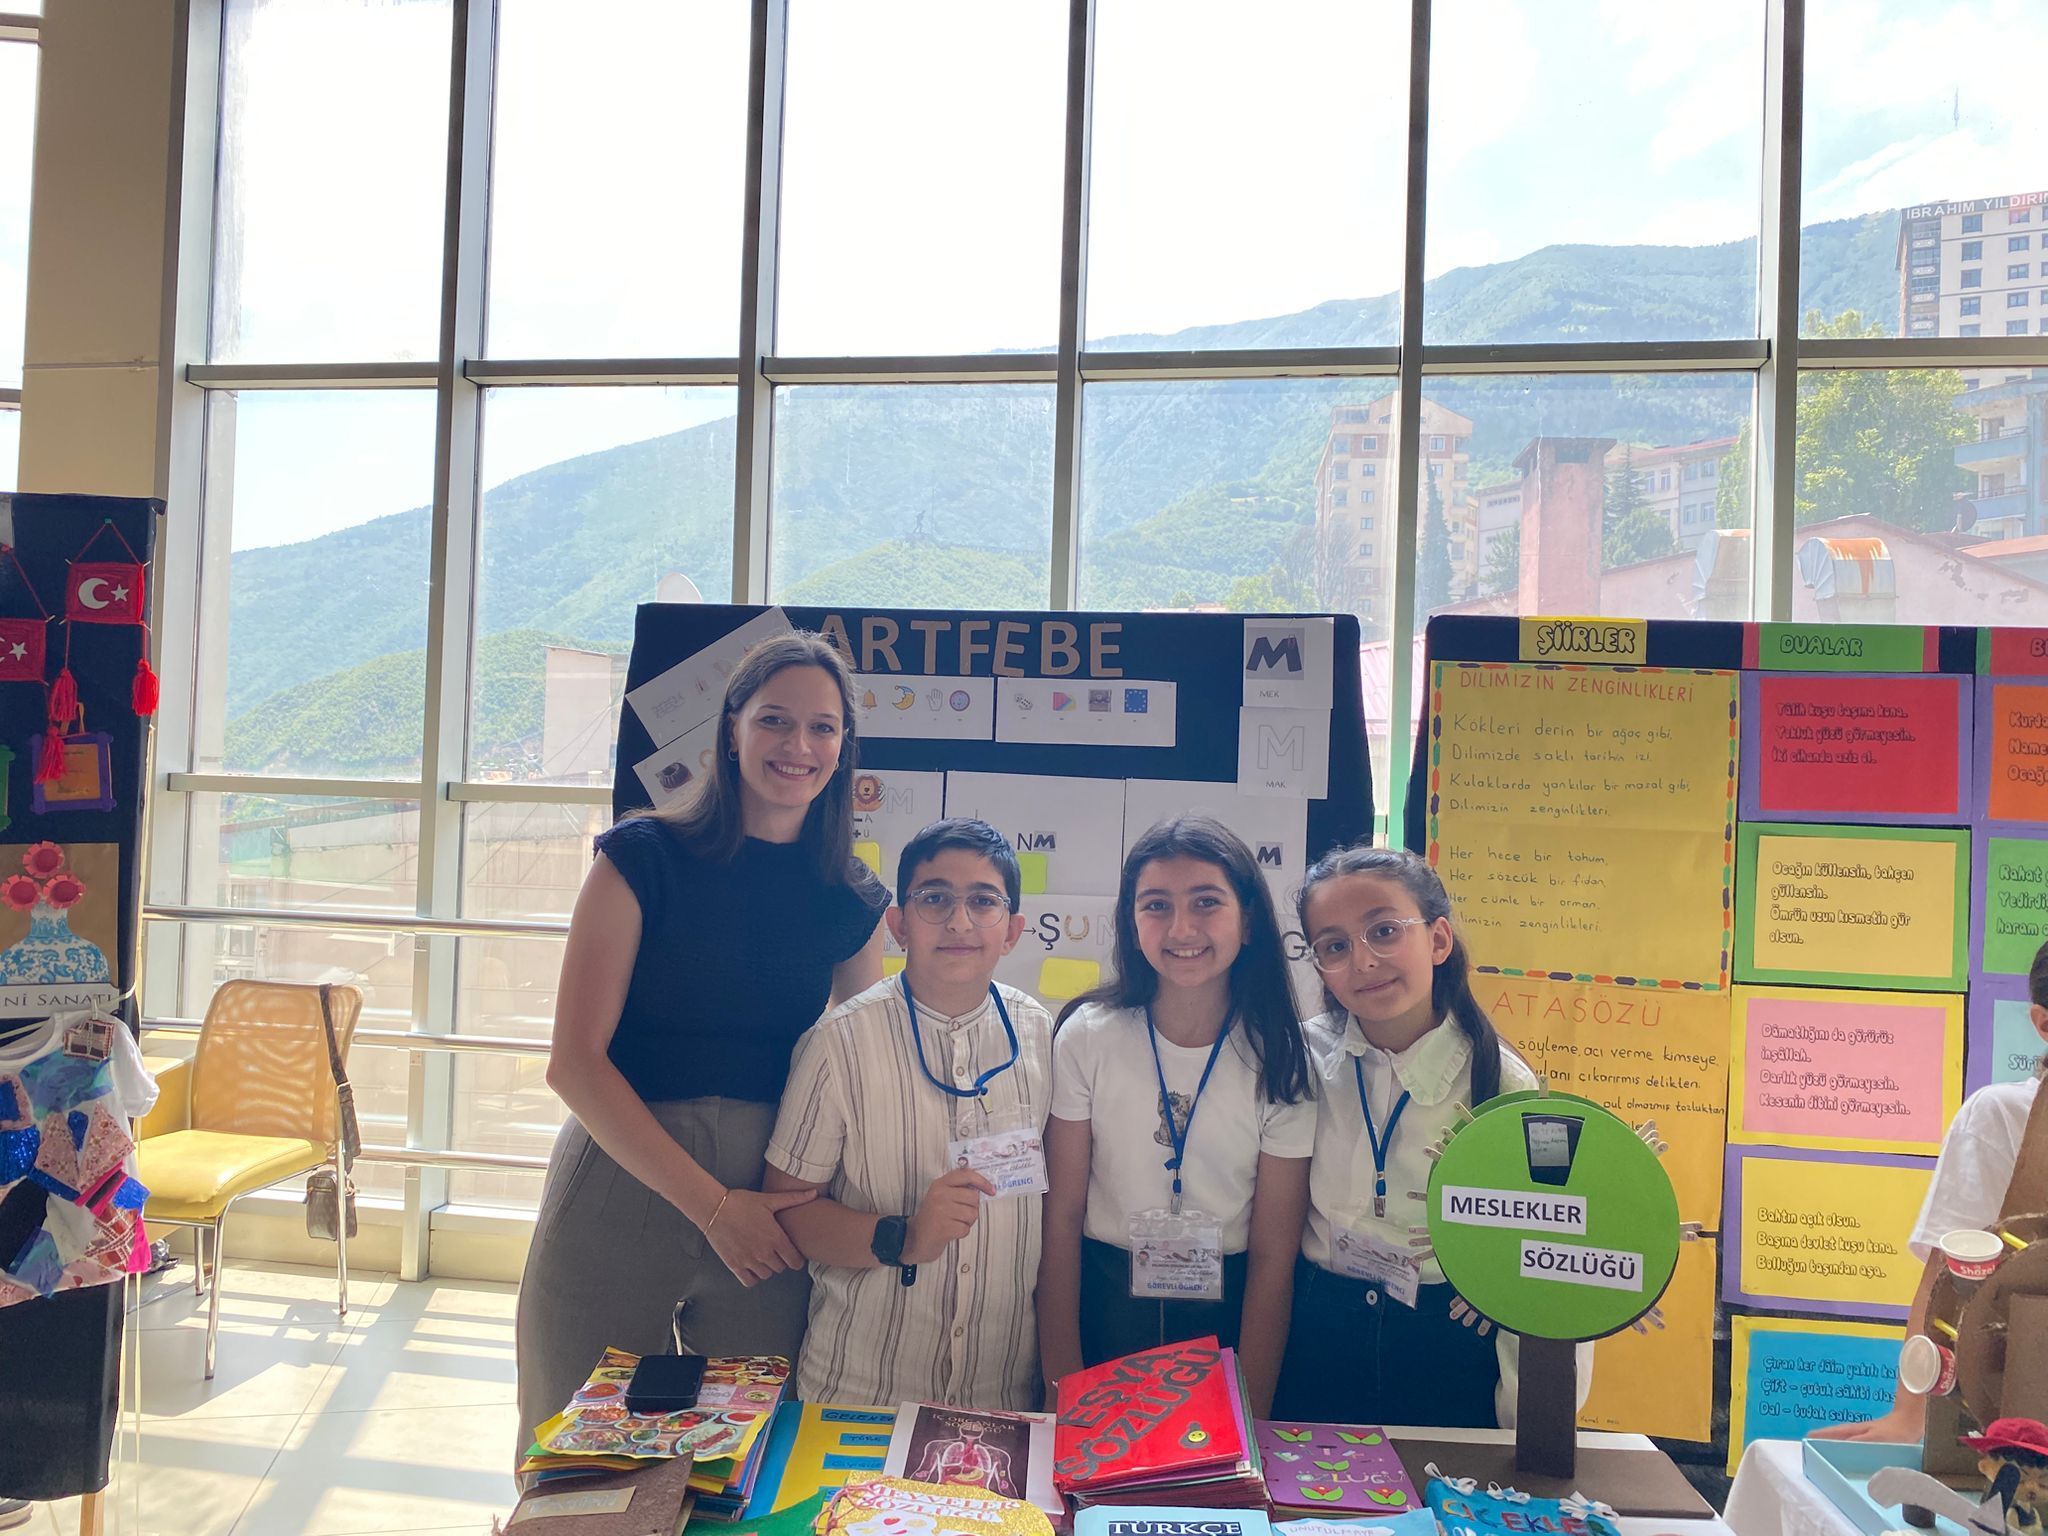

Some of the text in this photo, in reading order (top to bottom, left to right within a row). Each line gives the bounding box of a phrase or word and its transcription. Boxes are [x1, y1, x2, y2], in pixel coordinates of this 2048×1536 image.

[819, 614, 1124, 678] ARTFEBE
[1537, 621, 1635, 655] ŞİİRLER
[1780, 634, 1863, 657] DUALAR
[1535, 718, 1574, 737] derin
[1452, 743, 1521, 761] Dilimizde
[1450, 773, 1531, 790] Kulaklarda
[1450, 846, 1473, 859] Her
[1488, 846, 1521, 862] hece
[1450, 869, 1473, 881] Her
[1488, 872, 1537, 884] sözcük
[1772, 861, 1812, 879] Ocağın
[1874, 865, 1914, 883] bahçen
[1999, 864, 2042, 883] Rahat
[1481, 895, 1520, 905] cümle
[1771, 884, 1829, 900] güllensin.
[1770, 904, 1911, 929] Ömrün uzun kısmetin gür
[1769, 929, 1804, 944] olsun.
[1996, 919, 2039, 936] haram
[1491, 992, 1662, 1027] ATASÖZÜ
[1831, 1027, 1846, 1042] da
[1848, 1029, 1895, 1045] görürüz
[1611, 1048, 1654, 1061] verme
[1646, 1072, 1701, 1089] delikten.
[1760, 1069, 1900, 1094] Darlık yüzü görmeyesin.
[1760, 1093, 1911, 1118] Kesenin dibini görmeyesin.
[1451, 1195, 1582, 1224] MESLEKLER
[1758, 1207, 1861, 1229] Bahtın açık olsun.
[1757, 1231, 1898, 1255] Başına devlet kuşu kona.
[1523, 1247, 1636, 1280] SÖZLÜĞÜ
[1756, 1255, 1887, 1279] Bolluğun başından aşa.
[1796, 1357, 1816, 1372] her
[1761, 1378, 1787, 1396] Çift
[1801, 1382, 1833, 1398] çubuk
[1760, 1401, 1780, 1416] Dal
[1794, 1403, 1826, 1420] budak
[1110, 1520, 1241, 1536] TÜRKÇE
